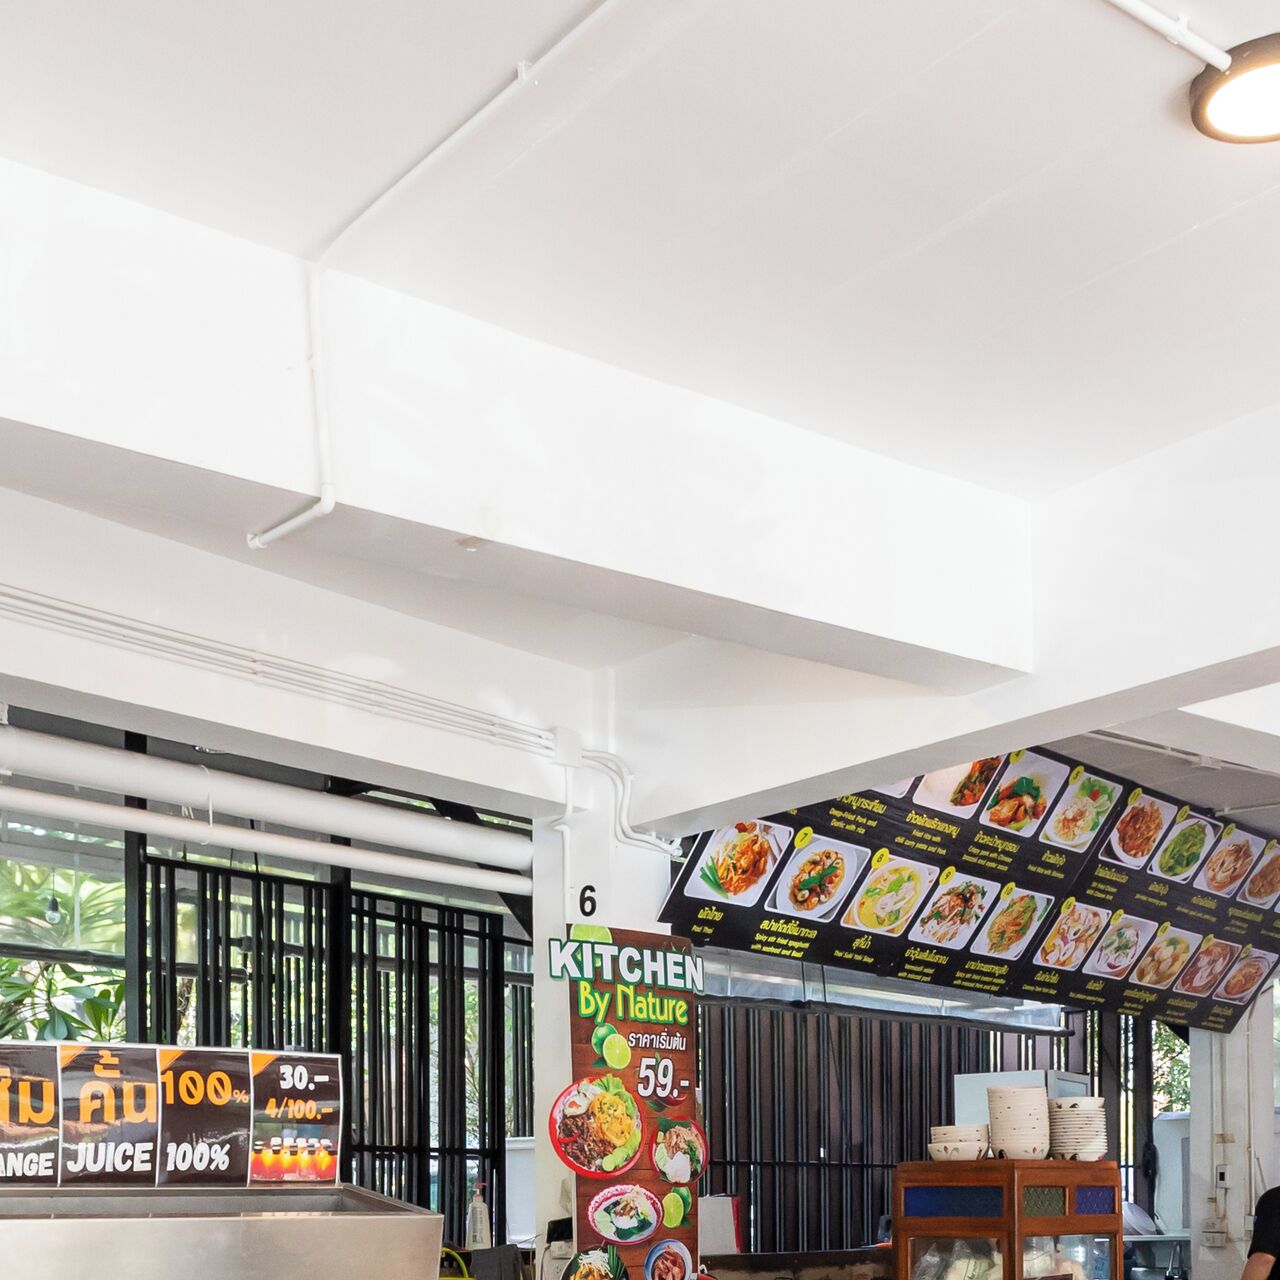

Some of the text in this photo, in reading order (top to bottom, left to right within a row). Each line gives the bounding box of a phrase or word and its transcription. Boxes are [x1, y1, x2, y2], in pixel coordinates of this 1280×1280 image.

[799, 833, 808, 843] 7
[578, 884, 597, 917] 6
[549, 939, 705, 993] KITCHEN
[578, 980, 689, 1024] By Nature
[628, 1027, 687, 1051] ราคาเริ่มต้น
[79, 1049, 157, 1124] คั้น
[67, 1141, 153, 1173] JUICE
[166, 1142, 231, 1172] 100%
